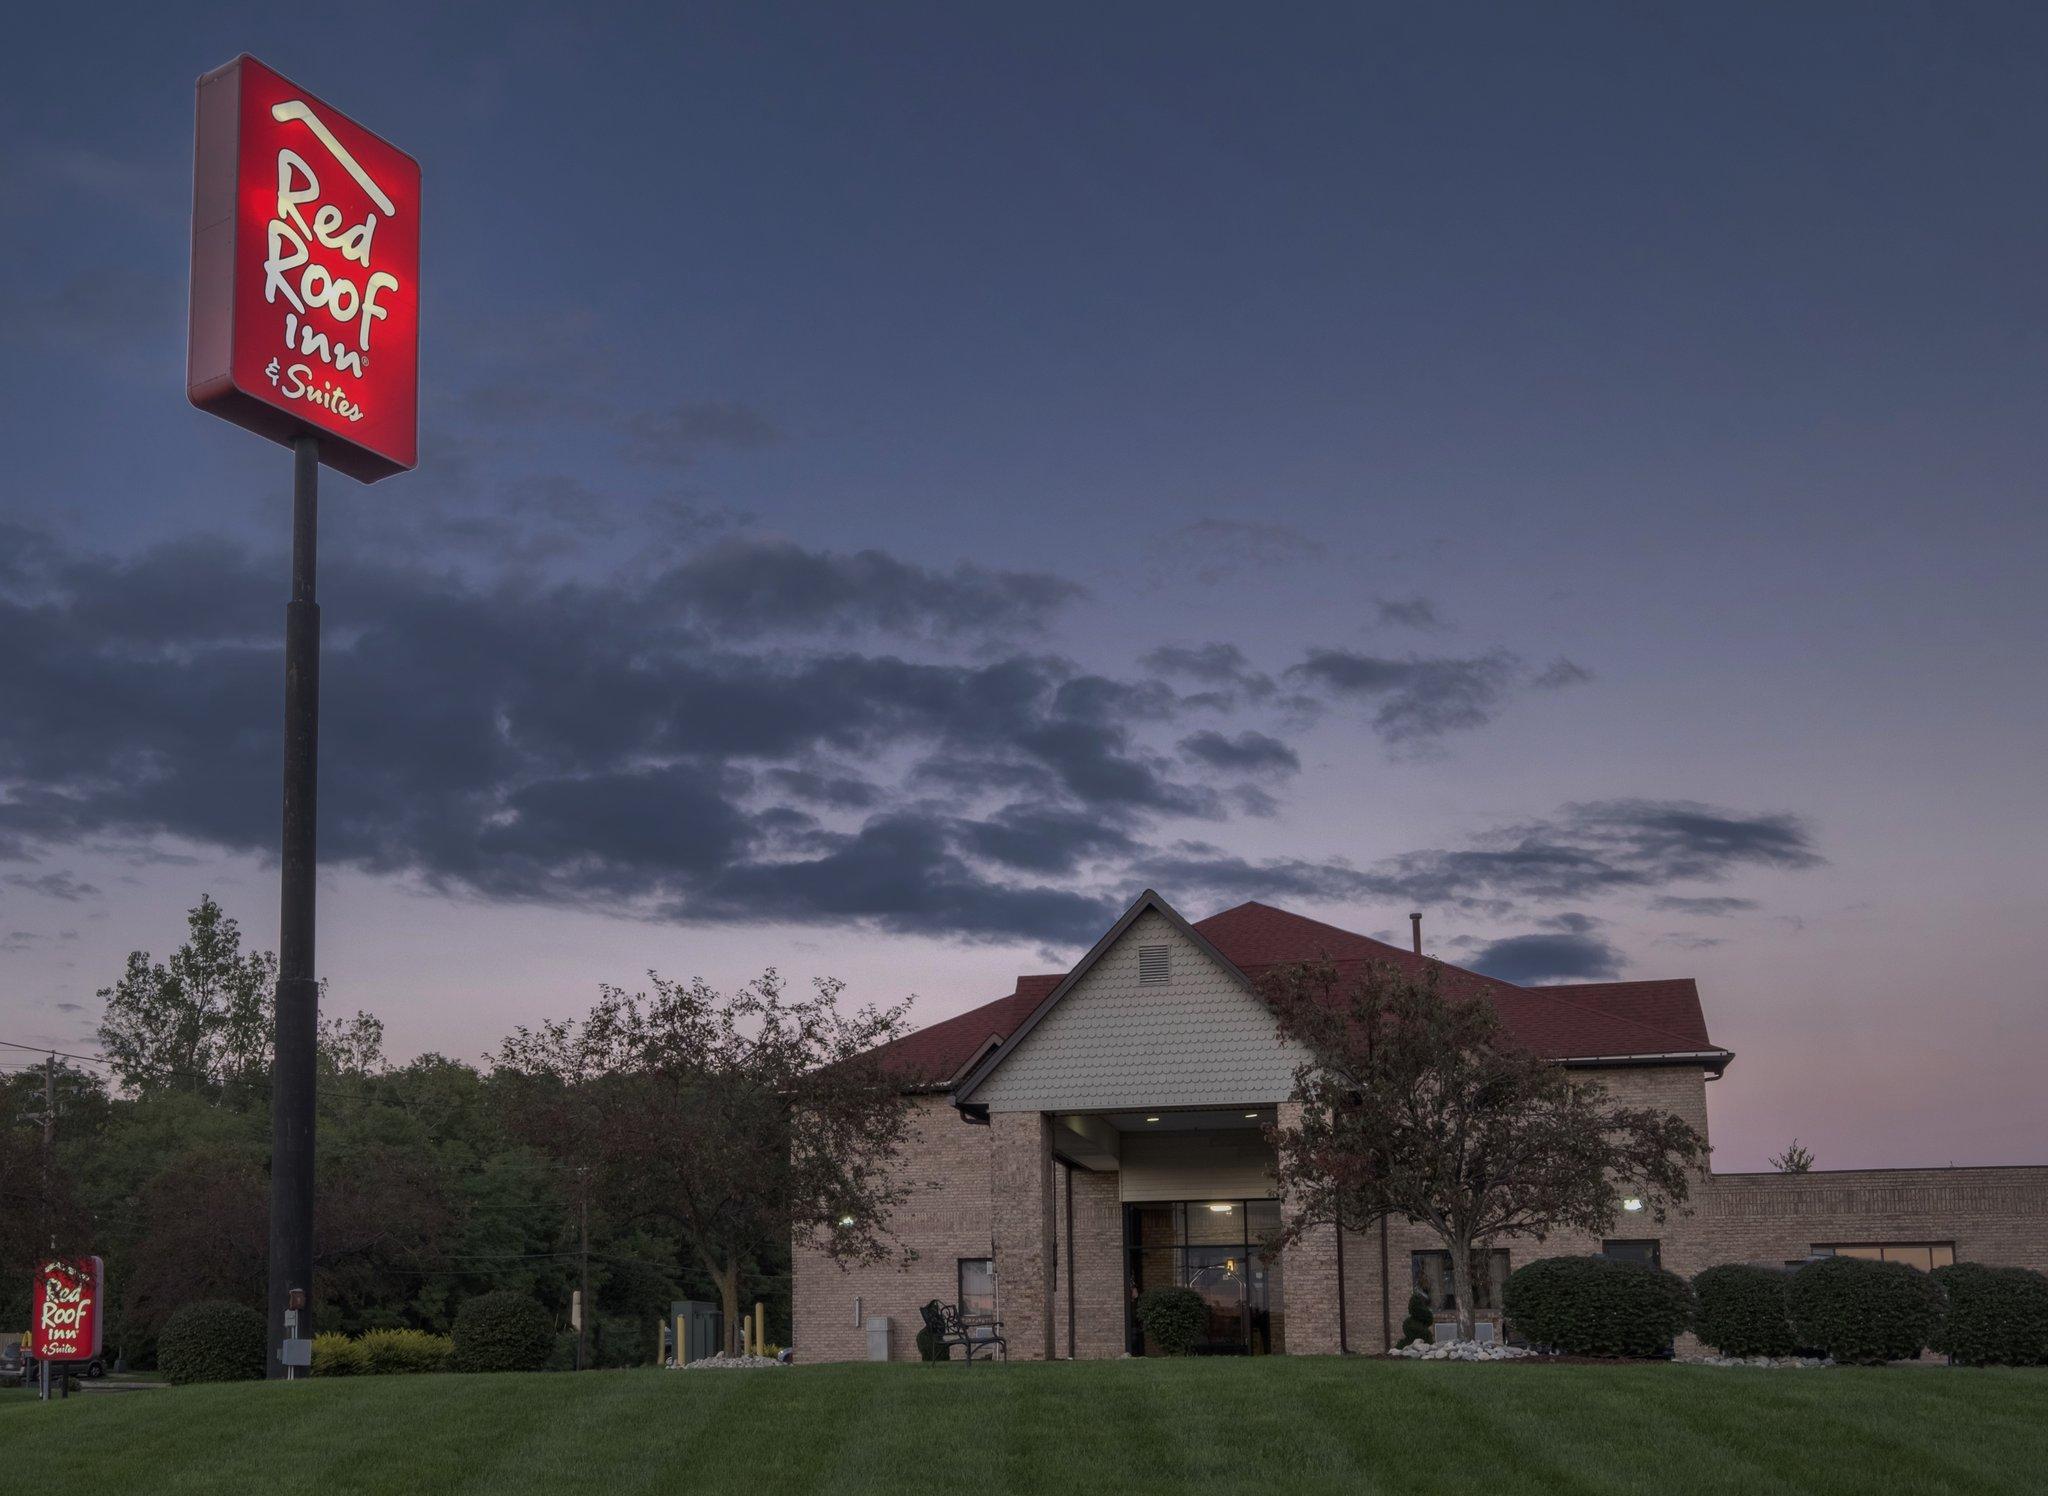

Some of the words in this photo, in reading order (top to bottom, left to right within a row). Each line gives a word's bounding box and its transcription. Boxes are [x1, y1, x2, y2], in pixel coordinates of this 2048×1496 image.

[278, 149, 377, 268] Red
[264, 218, 399, 352] Roof
[264, 357, 281, 387] &
[281, 363, 365, 422] Suites
[41, 1299, 91, 1330] Roof
[46, 1278, 82, 1303] Red
[47, 1342, 77, 1355] Suites
